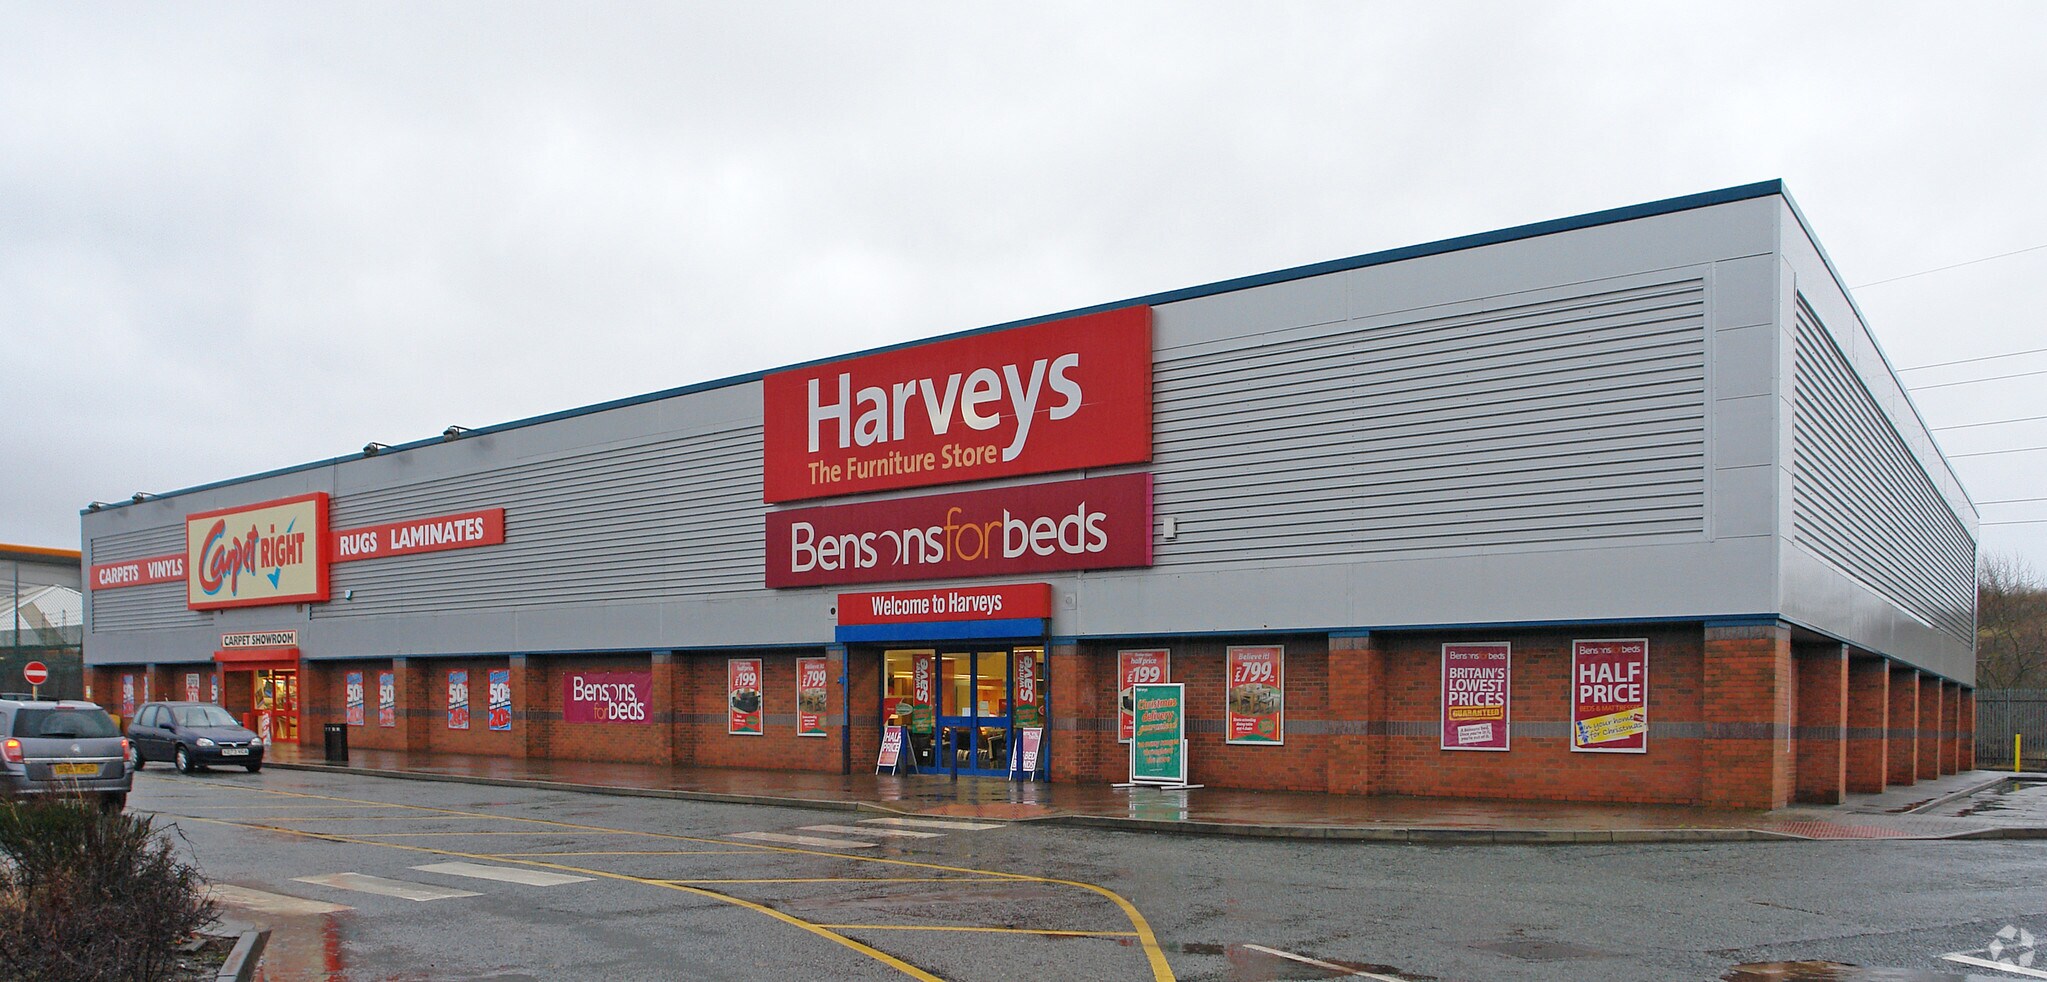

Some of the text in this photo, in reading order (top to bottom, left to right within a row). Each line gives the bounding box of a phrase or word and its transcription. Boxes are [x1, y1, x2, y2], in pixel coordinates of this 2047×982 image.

[808, 353, 1082, 462] Harveys
[808, 444, 997, 485] The Furniture Store
[339, 517, 483, 556] RUGS LAMINATES
[199, 518, 305, 596] Carpet RIGHT
[99, 558, 183, 585] CARPETS VINYLS
[871, 592, 1002, 616] Welcome to Harveys
[224, 633, 294, 646] CARPET SHOWROOM
[802, 670, 826, 687] £799
[917, 658, 929, 703] Save
[1020, 656, 1034, 703] Save
[1127, 666, 1160, 682] £199
[1234, 661, 1272, 682] £799
[1449, 668, 1505, 679] BRITAIN'S
[1580, 662, 1640, 684] HALF
[380, 685, 395, 704] 50
[573, 676, 636, 701] Bensons
[1449, 679, 1504, 692] LOWEST
[1580, 684, 1640, 703] PRICE
[1448, 692, 1504, 706] PRICES
[1453, 709, 1500, 717] GUARANTEED
[1594, 720, 1611, 732] your
[886, 732, 902, 742] HALF
[883, 742, 900, 752] PRICE
